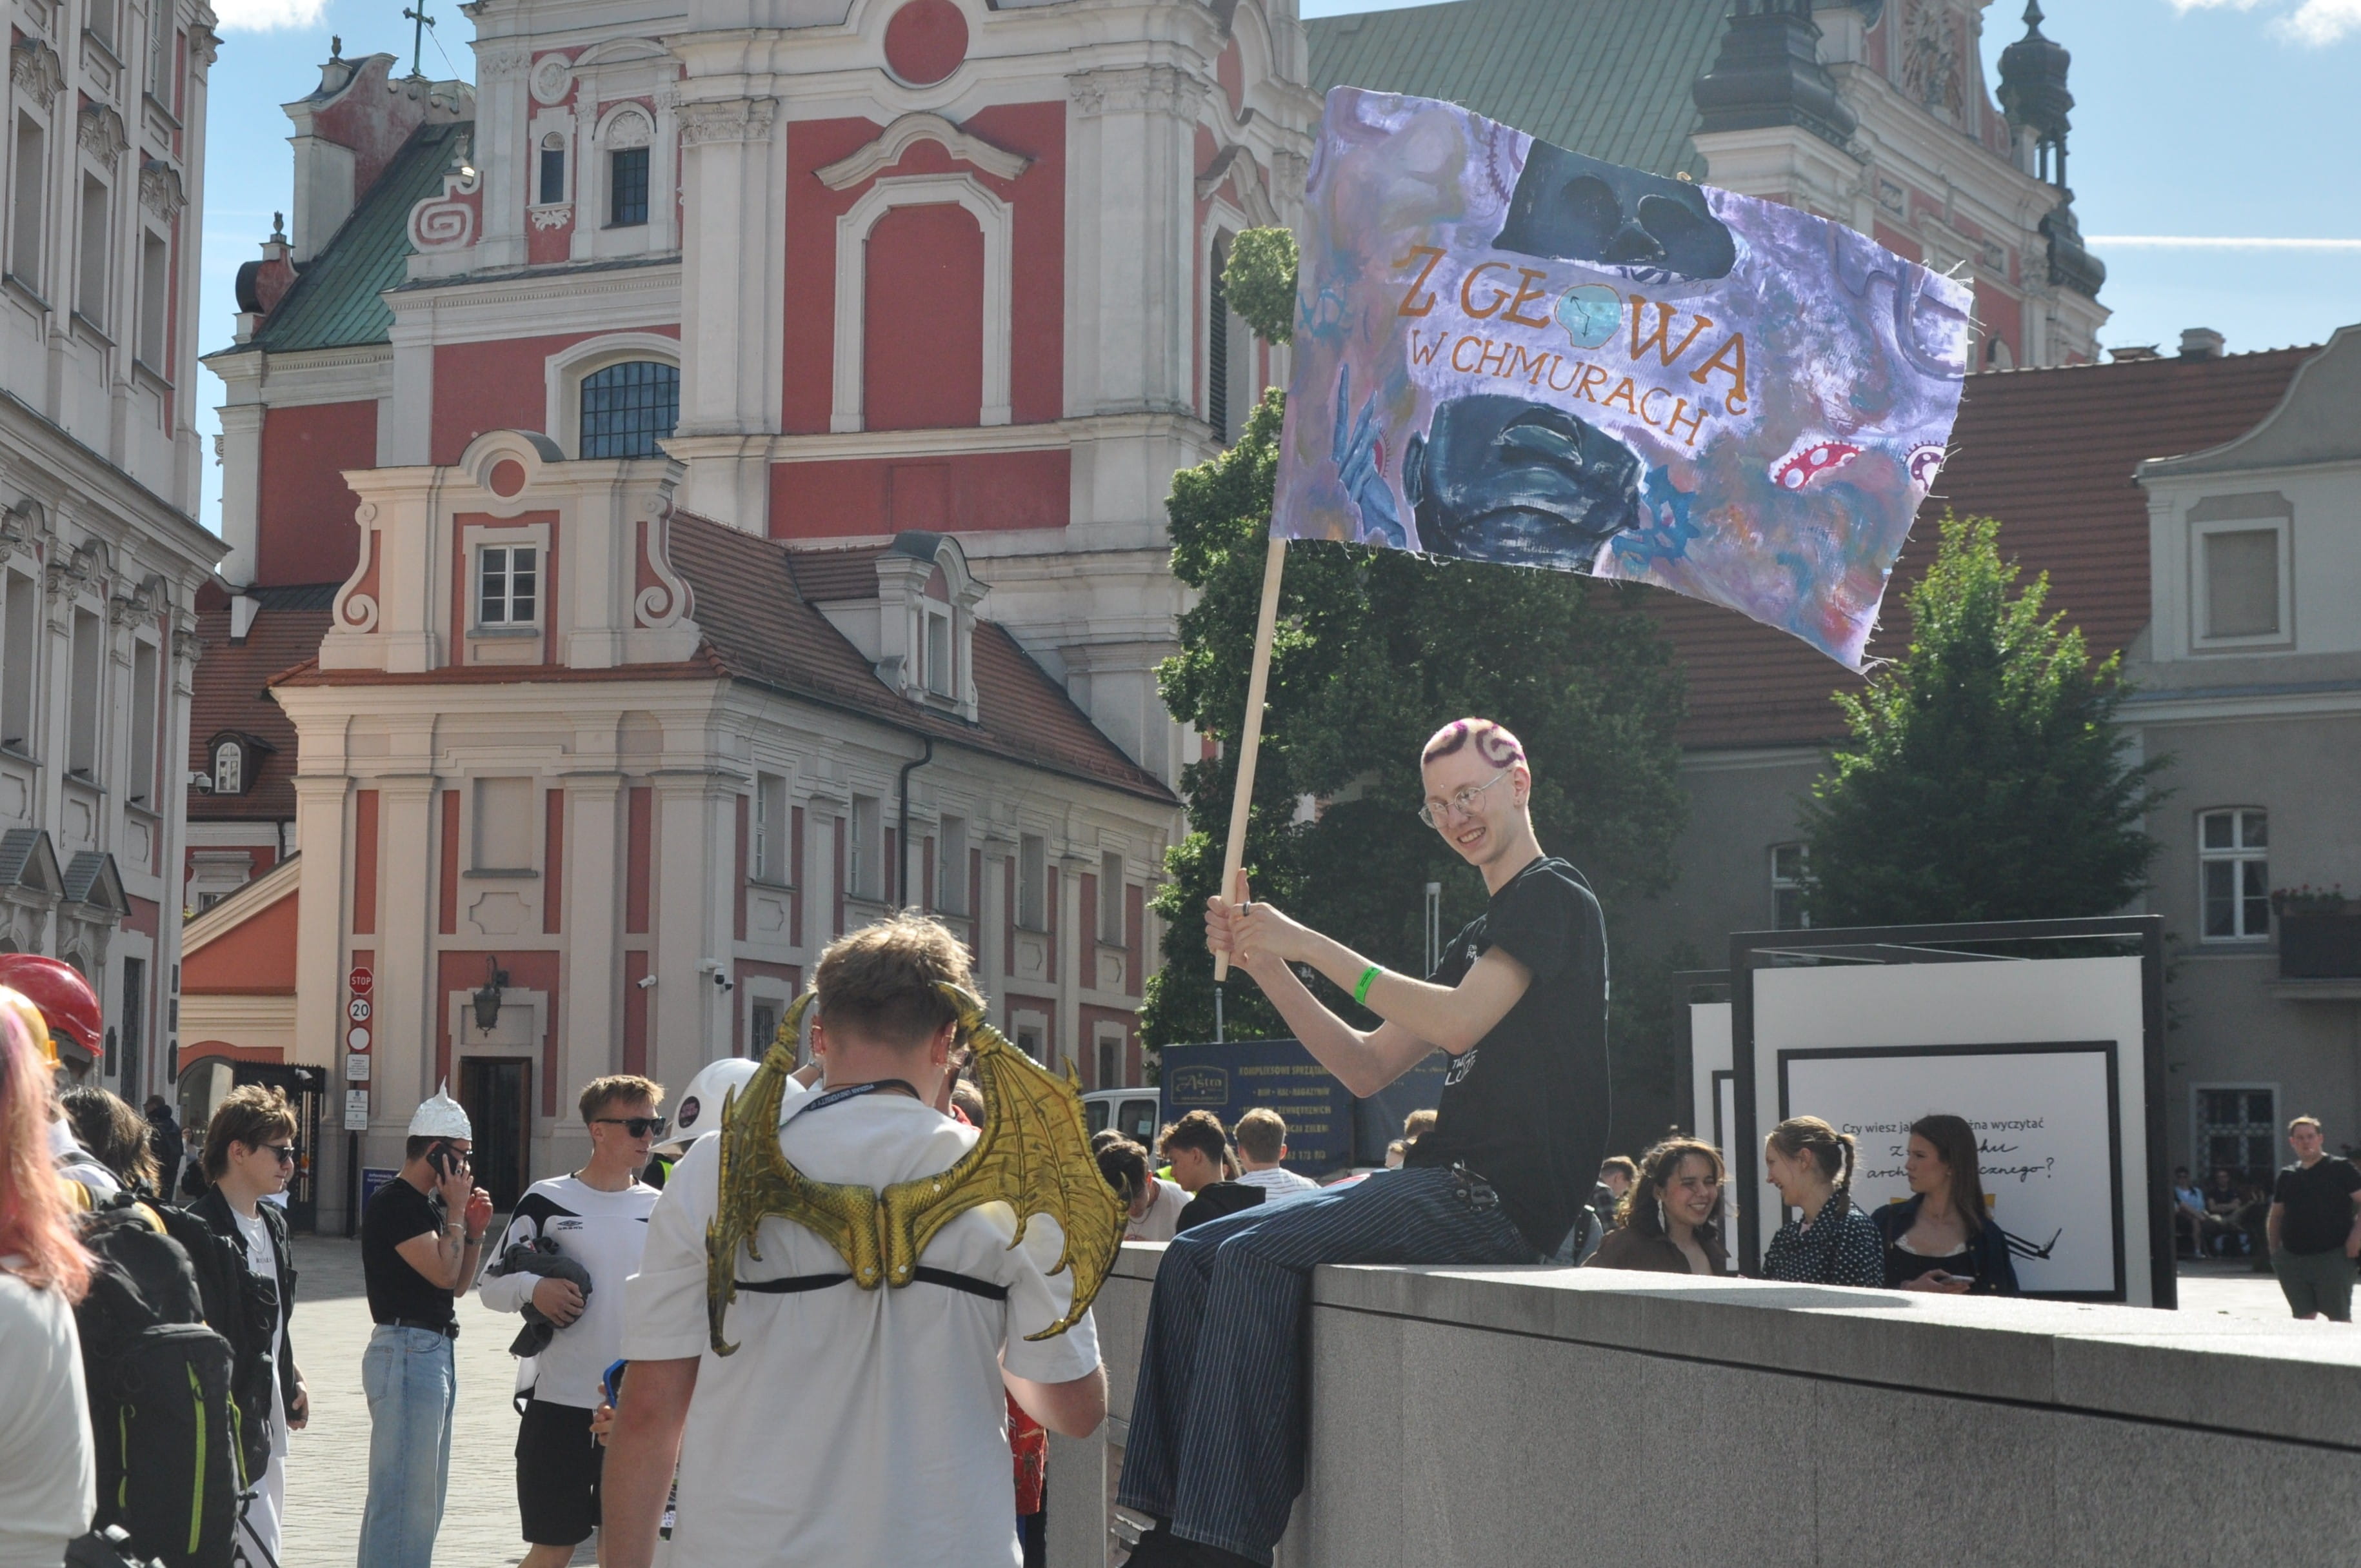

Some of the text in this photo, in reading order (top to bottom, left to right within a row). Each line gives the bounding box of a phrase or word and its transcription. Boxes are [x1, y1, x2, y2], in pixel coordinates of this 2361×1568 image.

[1391, 245, 1448, 317] Z
[1412, 330, 1709, 446] W CHMURACH
[351, 976, 372, 986] STOP
[352, 1004, 369, 1017] 20
[1842, 1123, 1862, 1135] Czy
[1866, 1122, 1897, 1133] wiesz
[1991, 1117, 2044, 1131] wyczytać
